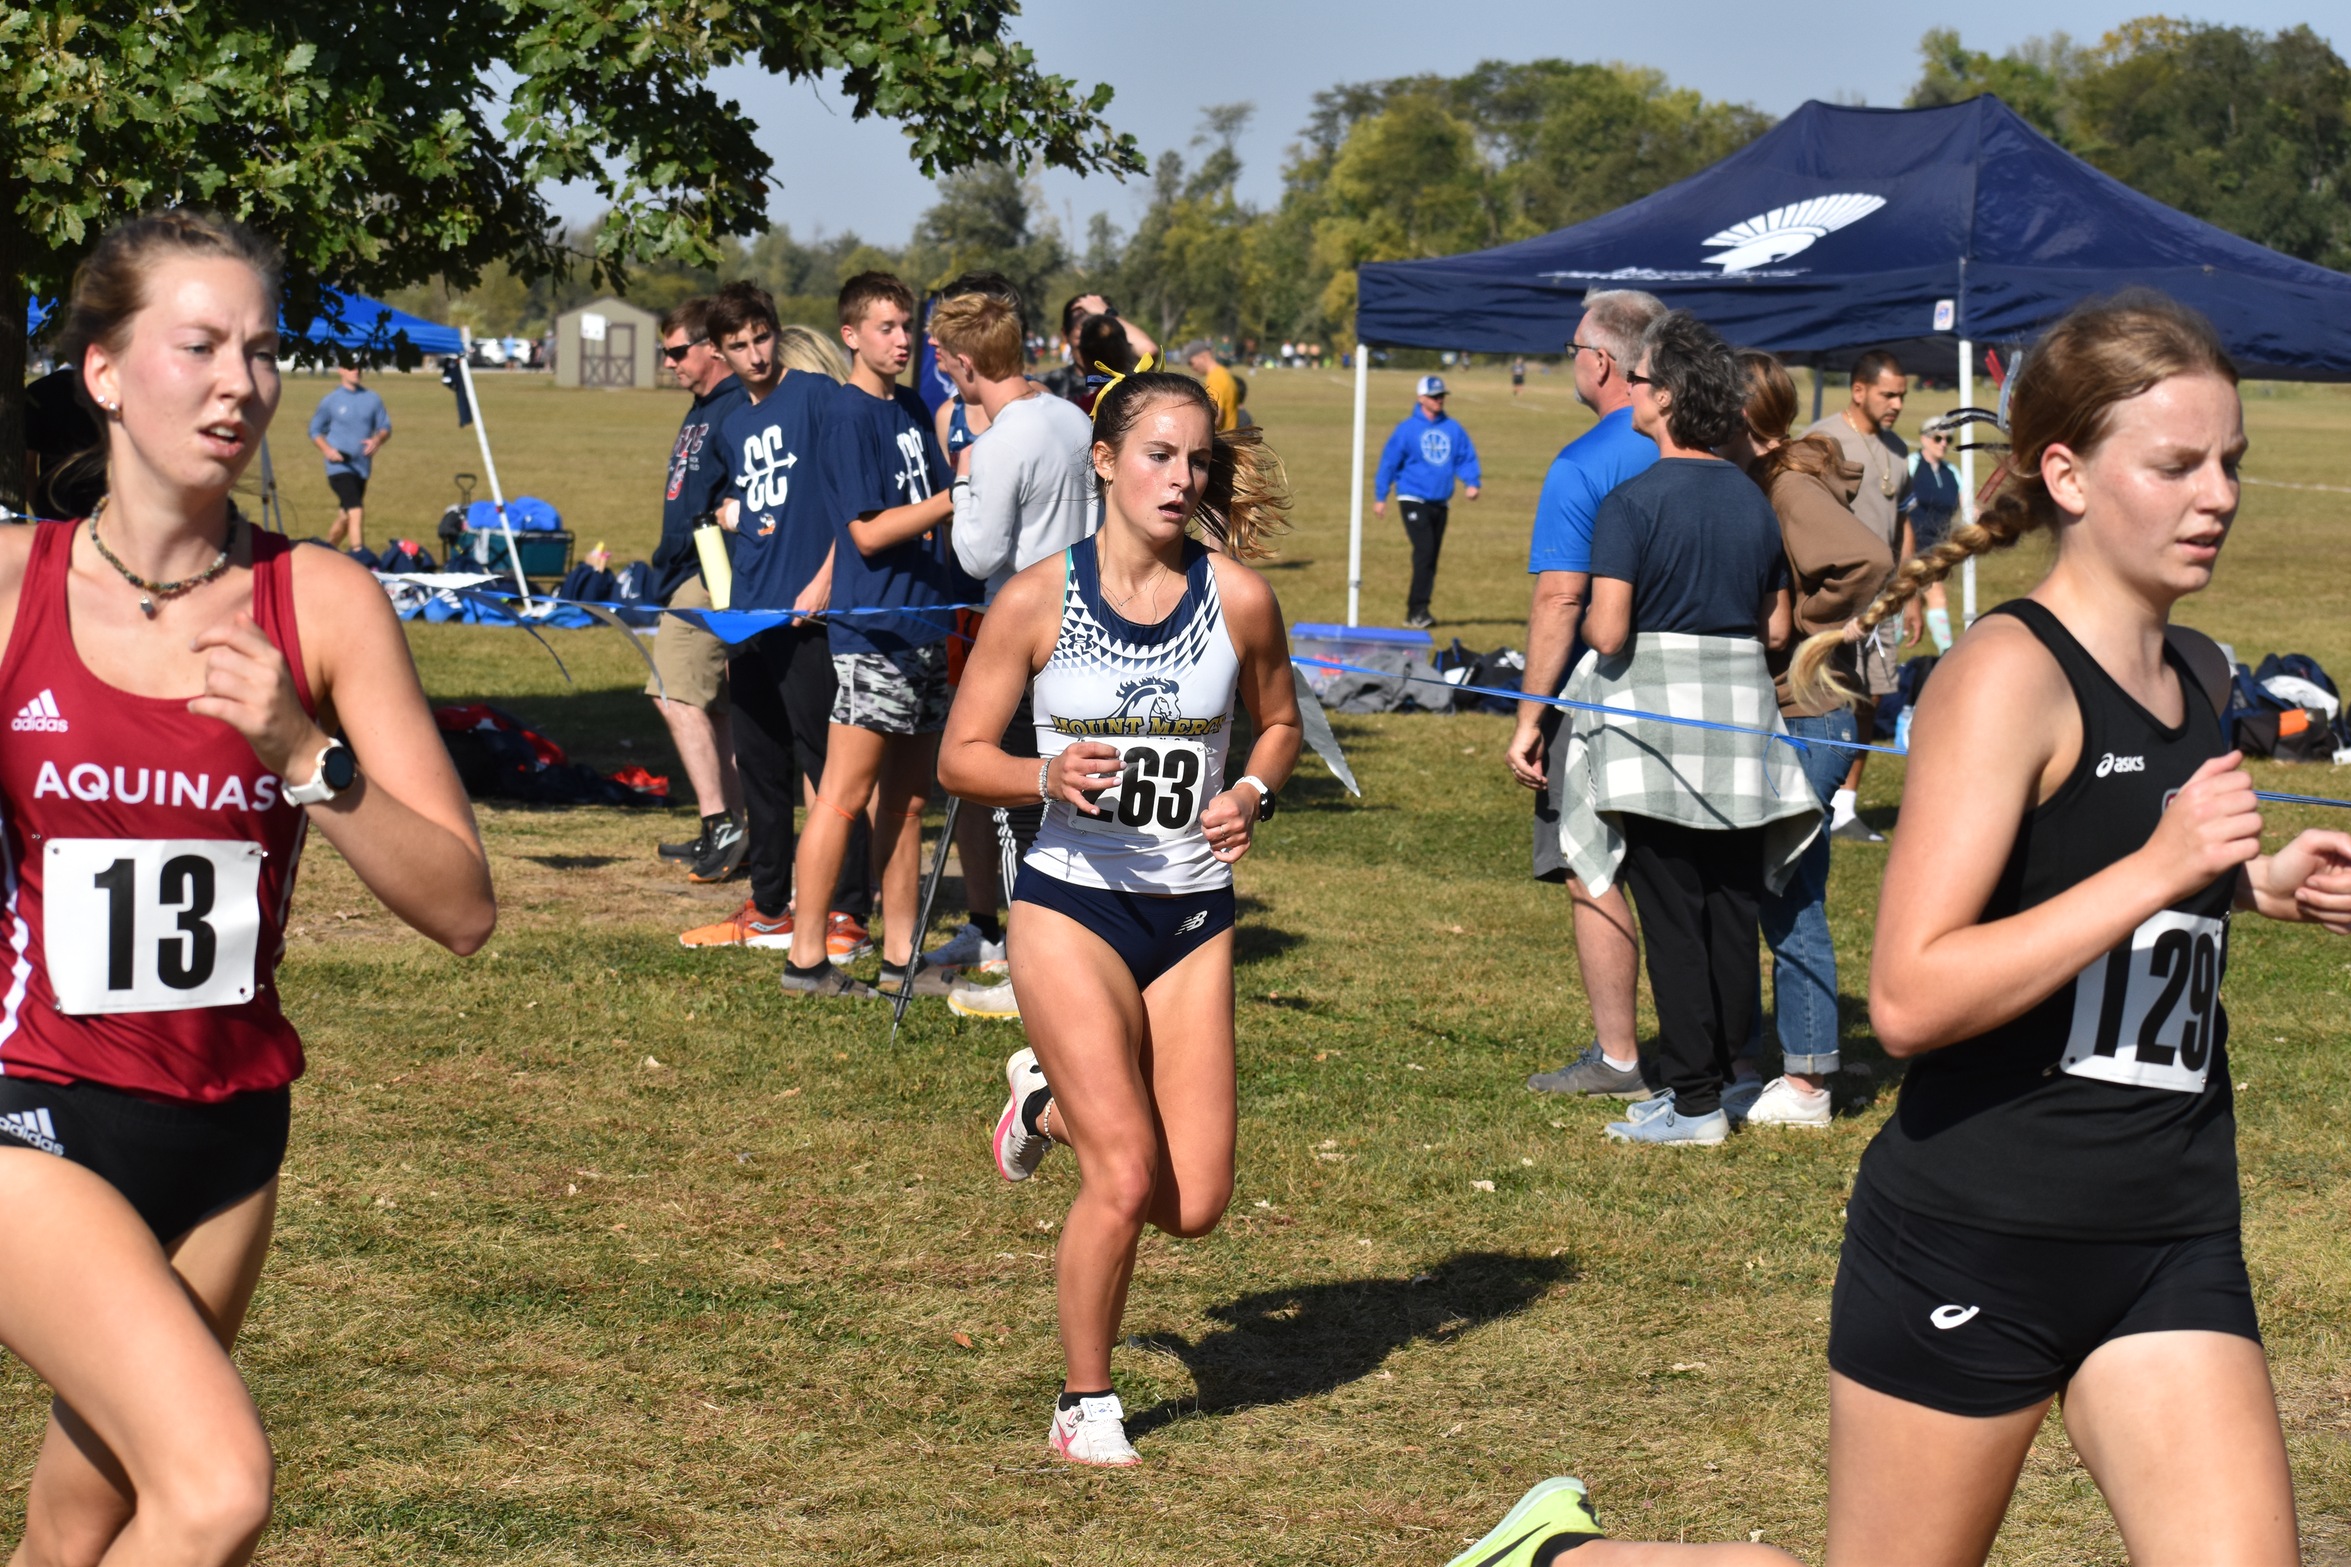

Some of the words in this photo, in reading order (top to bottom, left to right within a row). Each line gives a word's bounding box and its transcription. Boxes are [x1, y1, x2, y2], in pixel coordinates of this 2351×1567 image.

[11, 716, 69, 733] adidas
[1050, 714, 1145, 735] MOUNT
[2113, 755, 2146, 773] asics
[33, 760, 277, 812] AQUINAS
[94, 854, 217, 993] 13
[2093, 928, 2216, 1072] 129
